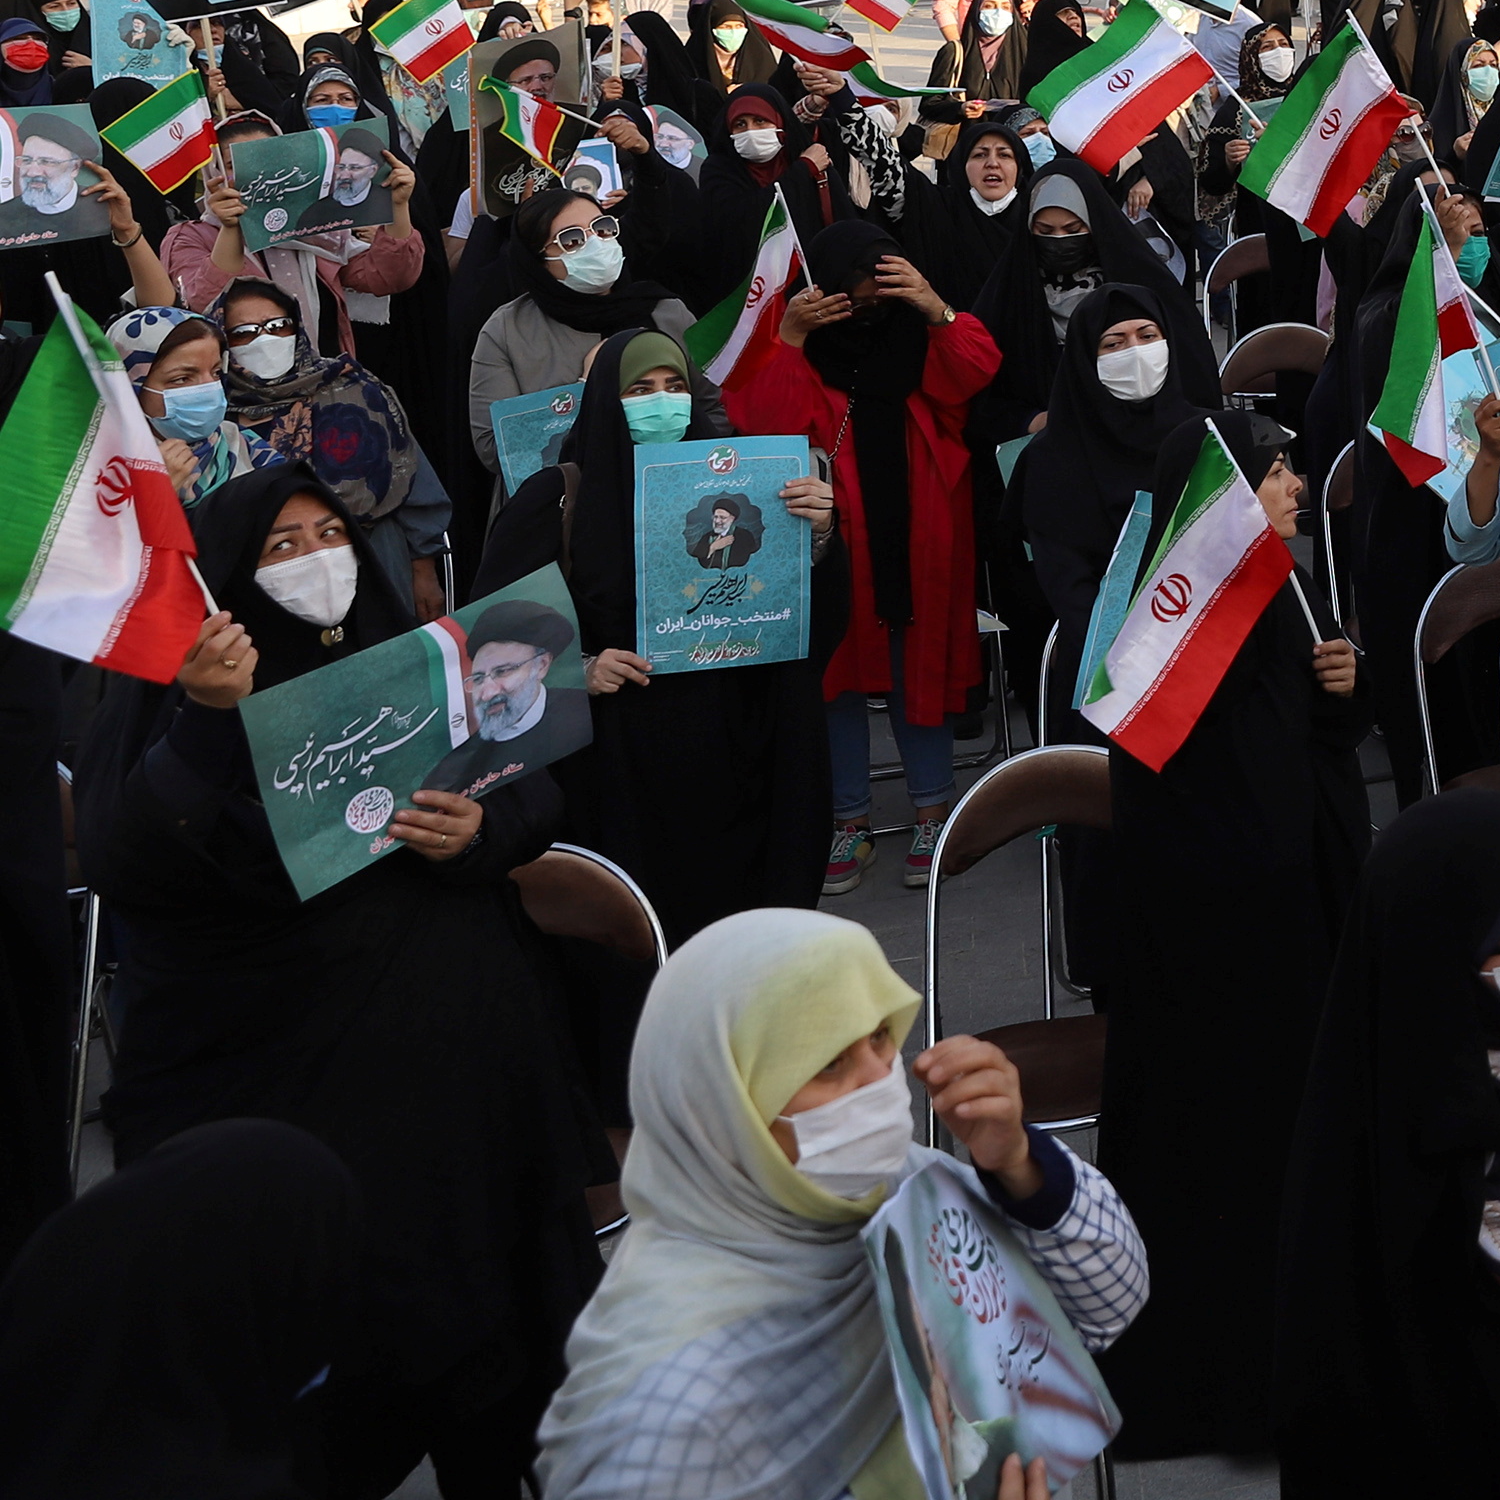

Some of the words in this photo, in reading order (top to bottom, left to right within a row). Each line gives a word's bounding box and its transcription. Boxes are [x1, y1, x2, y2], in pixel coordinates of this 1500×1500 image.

[656, 607, 791, 633] #منتخب_جوانان_ایران
[273, 731, 316, 801] رئیسی
[306, 706, 393, 805] ابراهیم
[501, 761, 524, 776] ستاد
[469, 770, 500, 795] حامیان
